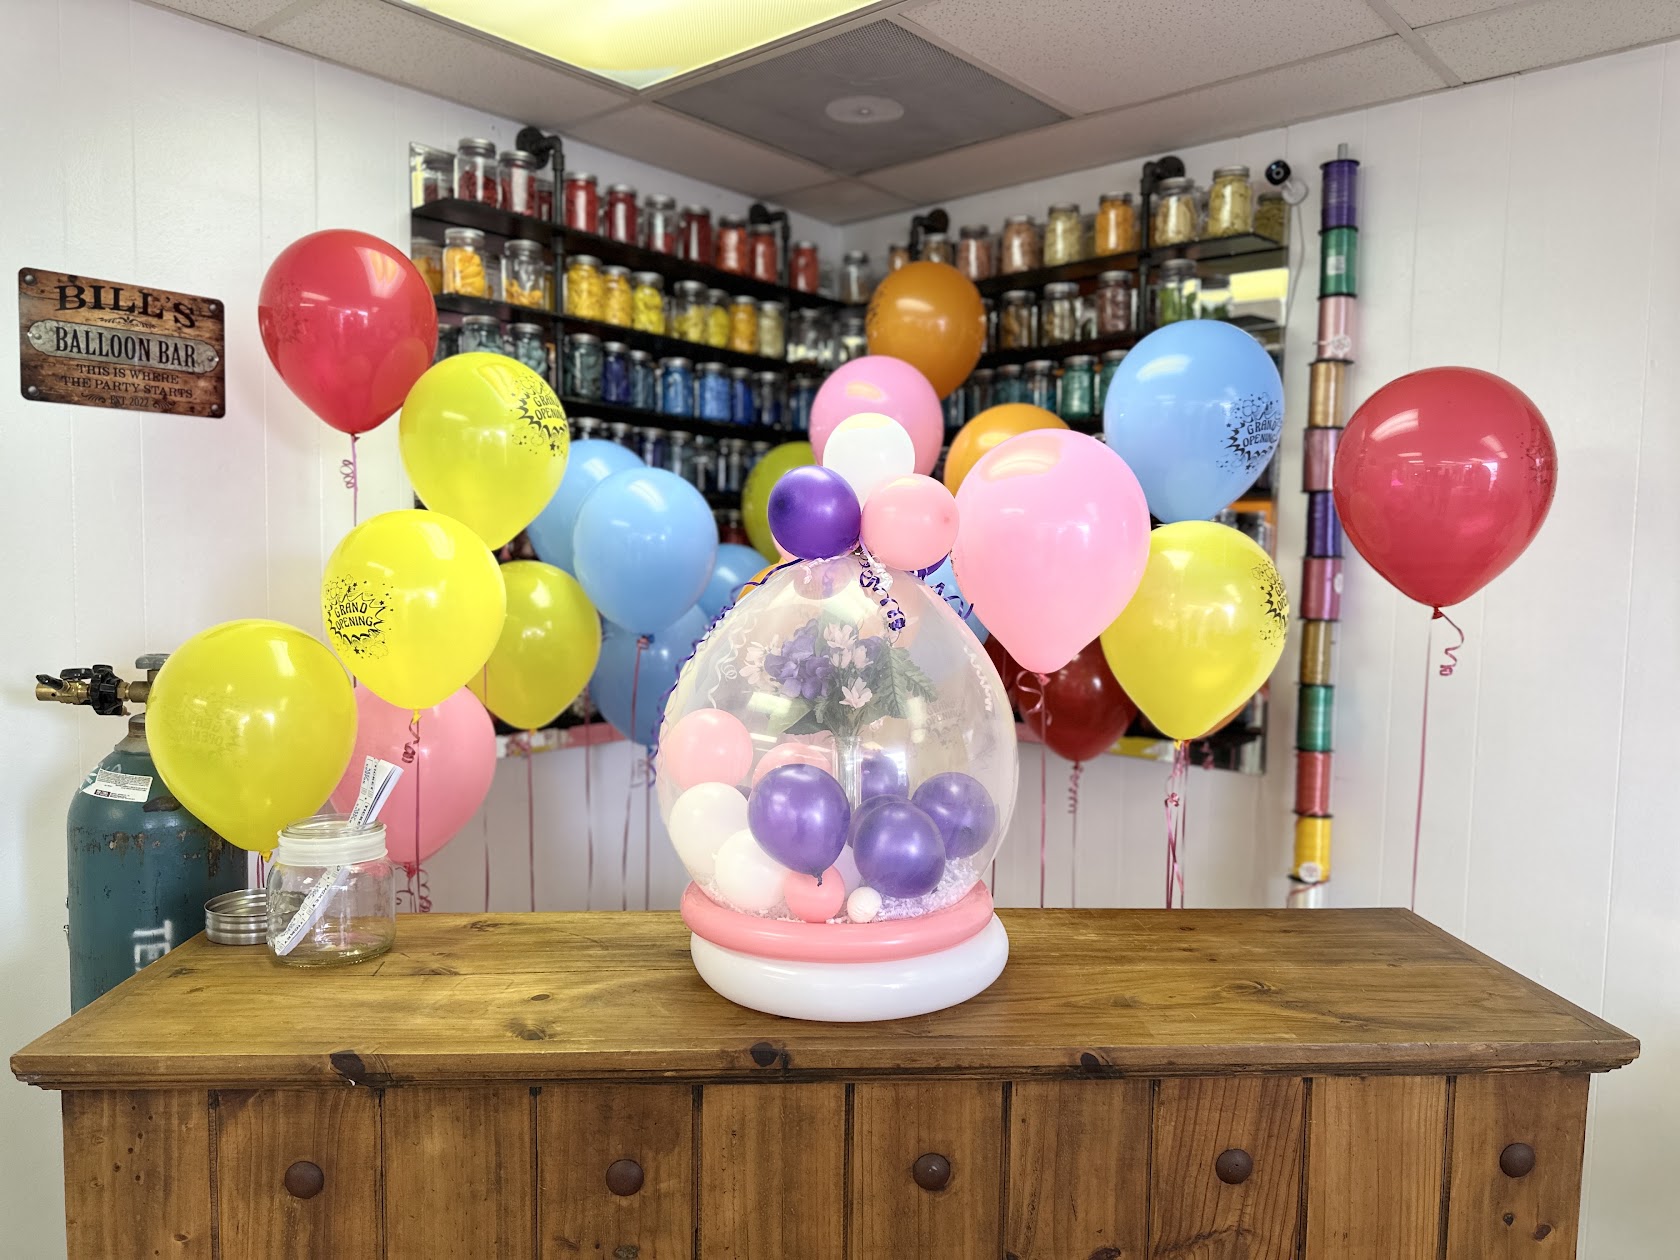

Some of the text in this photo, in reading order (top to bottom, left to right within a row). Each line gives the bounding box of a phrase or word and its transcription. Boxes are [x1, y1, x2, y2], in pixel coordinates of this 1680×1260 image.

[54, 284, 196, 329] BILL'S
[54, 326, 196, 368] BALLOON BAR
[77, 363, 179, 385] THIS IS WHERE
[61, 375, 193, 399] THE PARTY STARTS
[129, 396, 149, 408] 2022
[1247, 419, 1277, 435] GRAND
[334, 602, 368, 618] GRAND
[335, 615, 373, 631] OPENING
